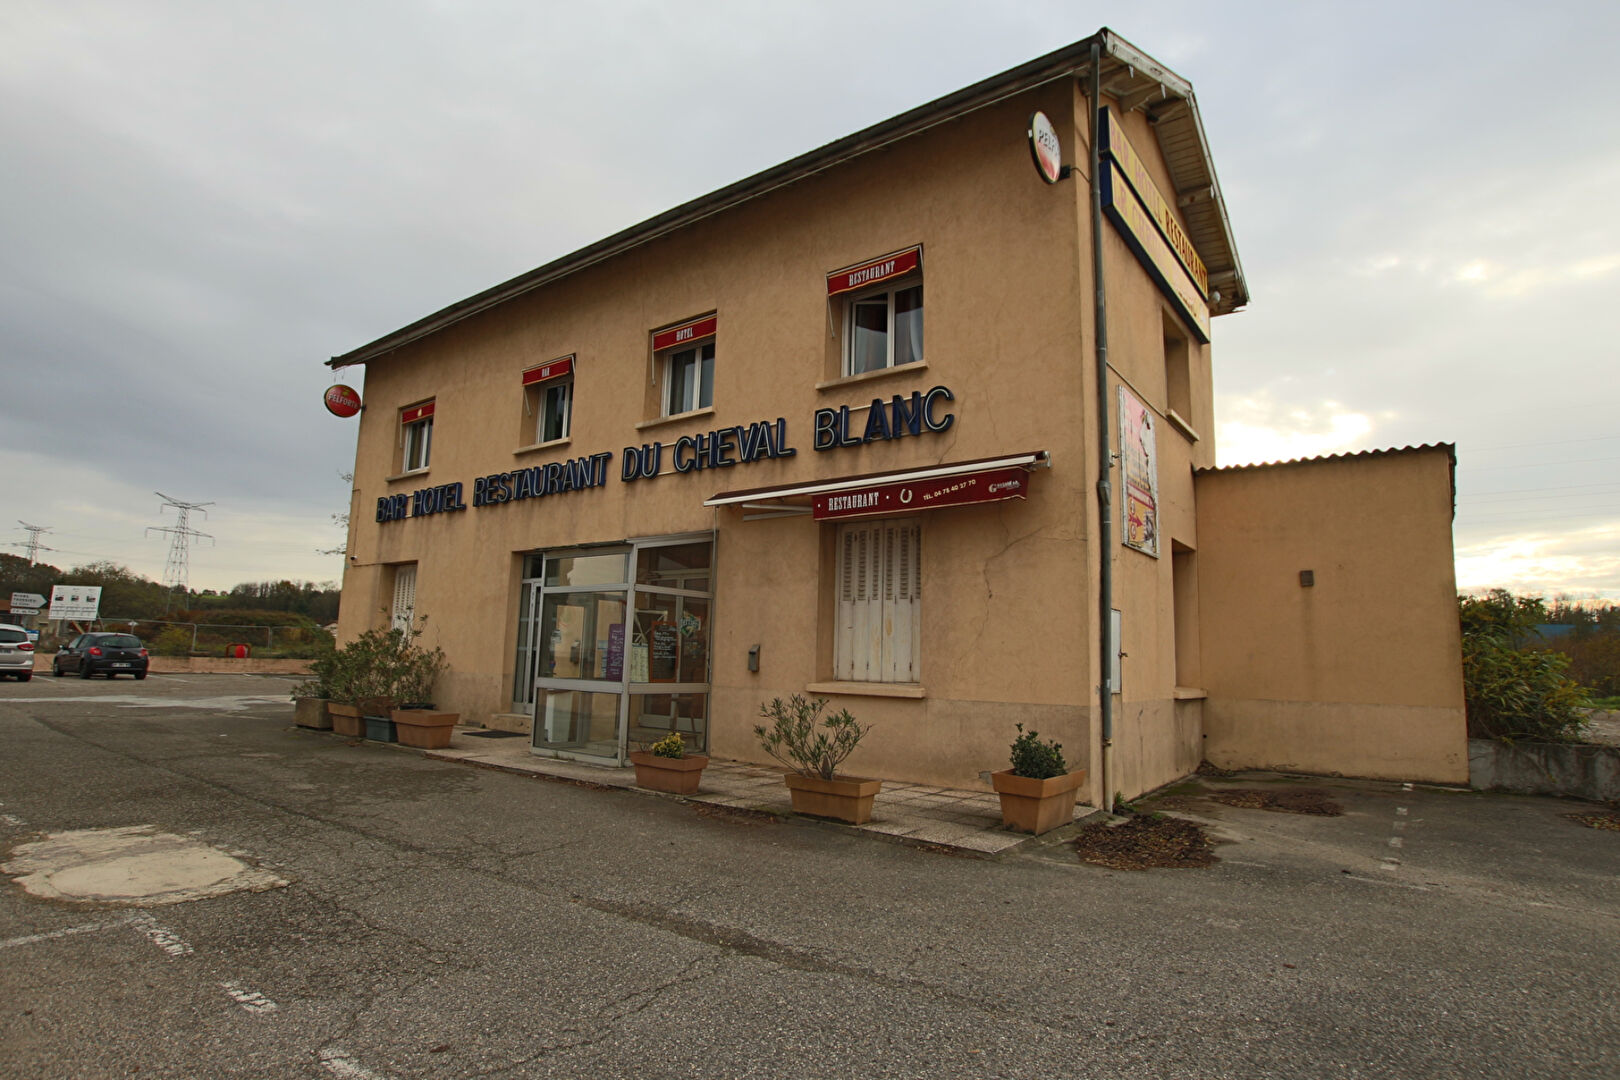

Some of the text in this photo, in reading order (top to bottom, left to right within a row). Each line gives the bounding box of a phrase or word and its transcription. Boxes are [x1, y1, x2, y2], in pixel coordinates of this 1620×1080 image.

[849, 261, 896, 286] RESTAURANT
[1165, 206, 1206, 295] RESTAURANT
[376, 385, 955, 522] BAR HOTEL RESTAURANT DU CHEVAL BLANC
[828, 492, 879, 511] RESTAURANT
[968, 478, 977, 486] 70
